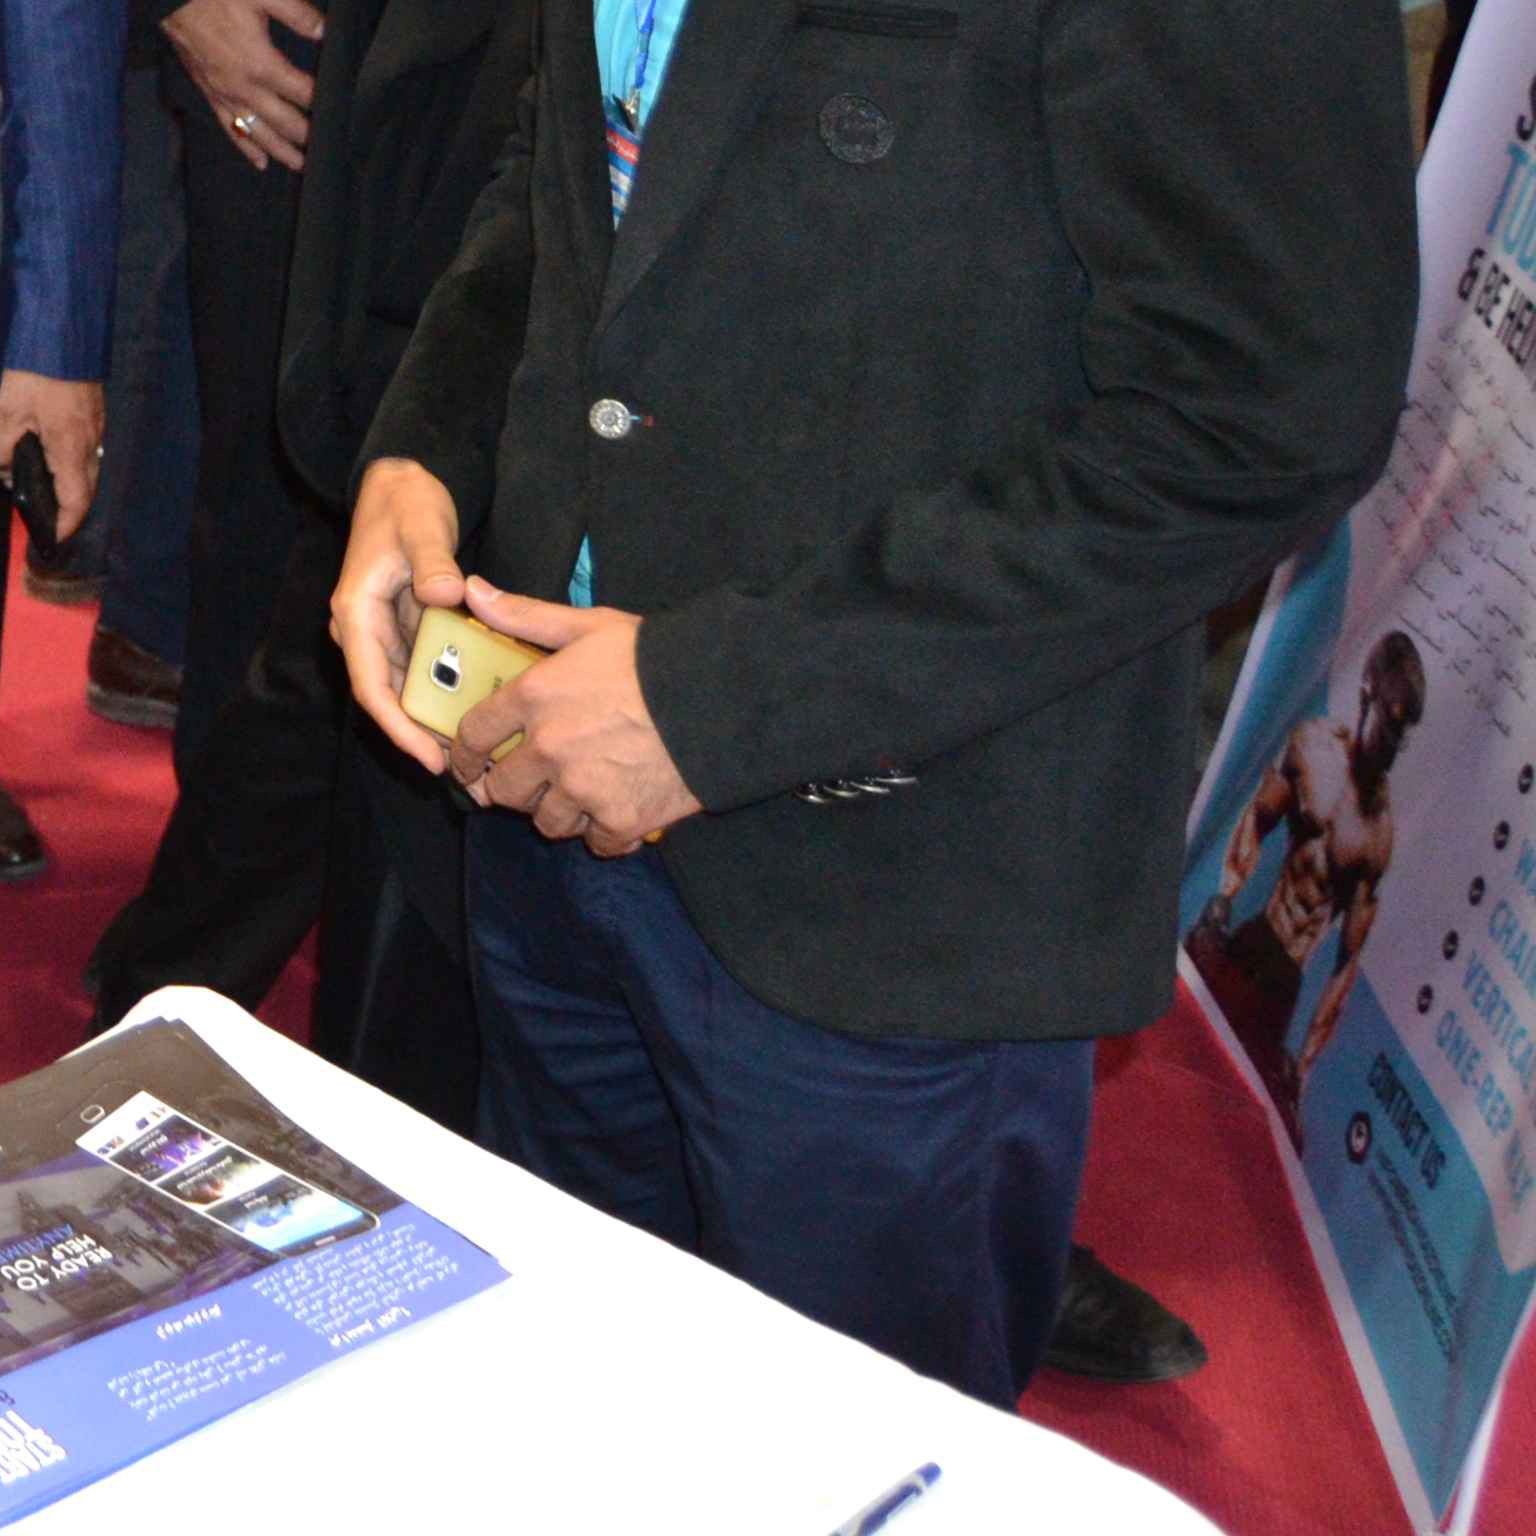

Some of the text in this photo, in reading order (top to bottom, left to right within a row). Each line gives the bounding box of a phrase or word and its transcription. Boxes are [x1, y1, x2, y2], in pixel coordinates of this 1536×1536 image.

[45, 1234, 96, 1260] HELP
[12, 1245, 112, 1292] READY TO
